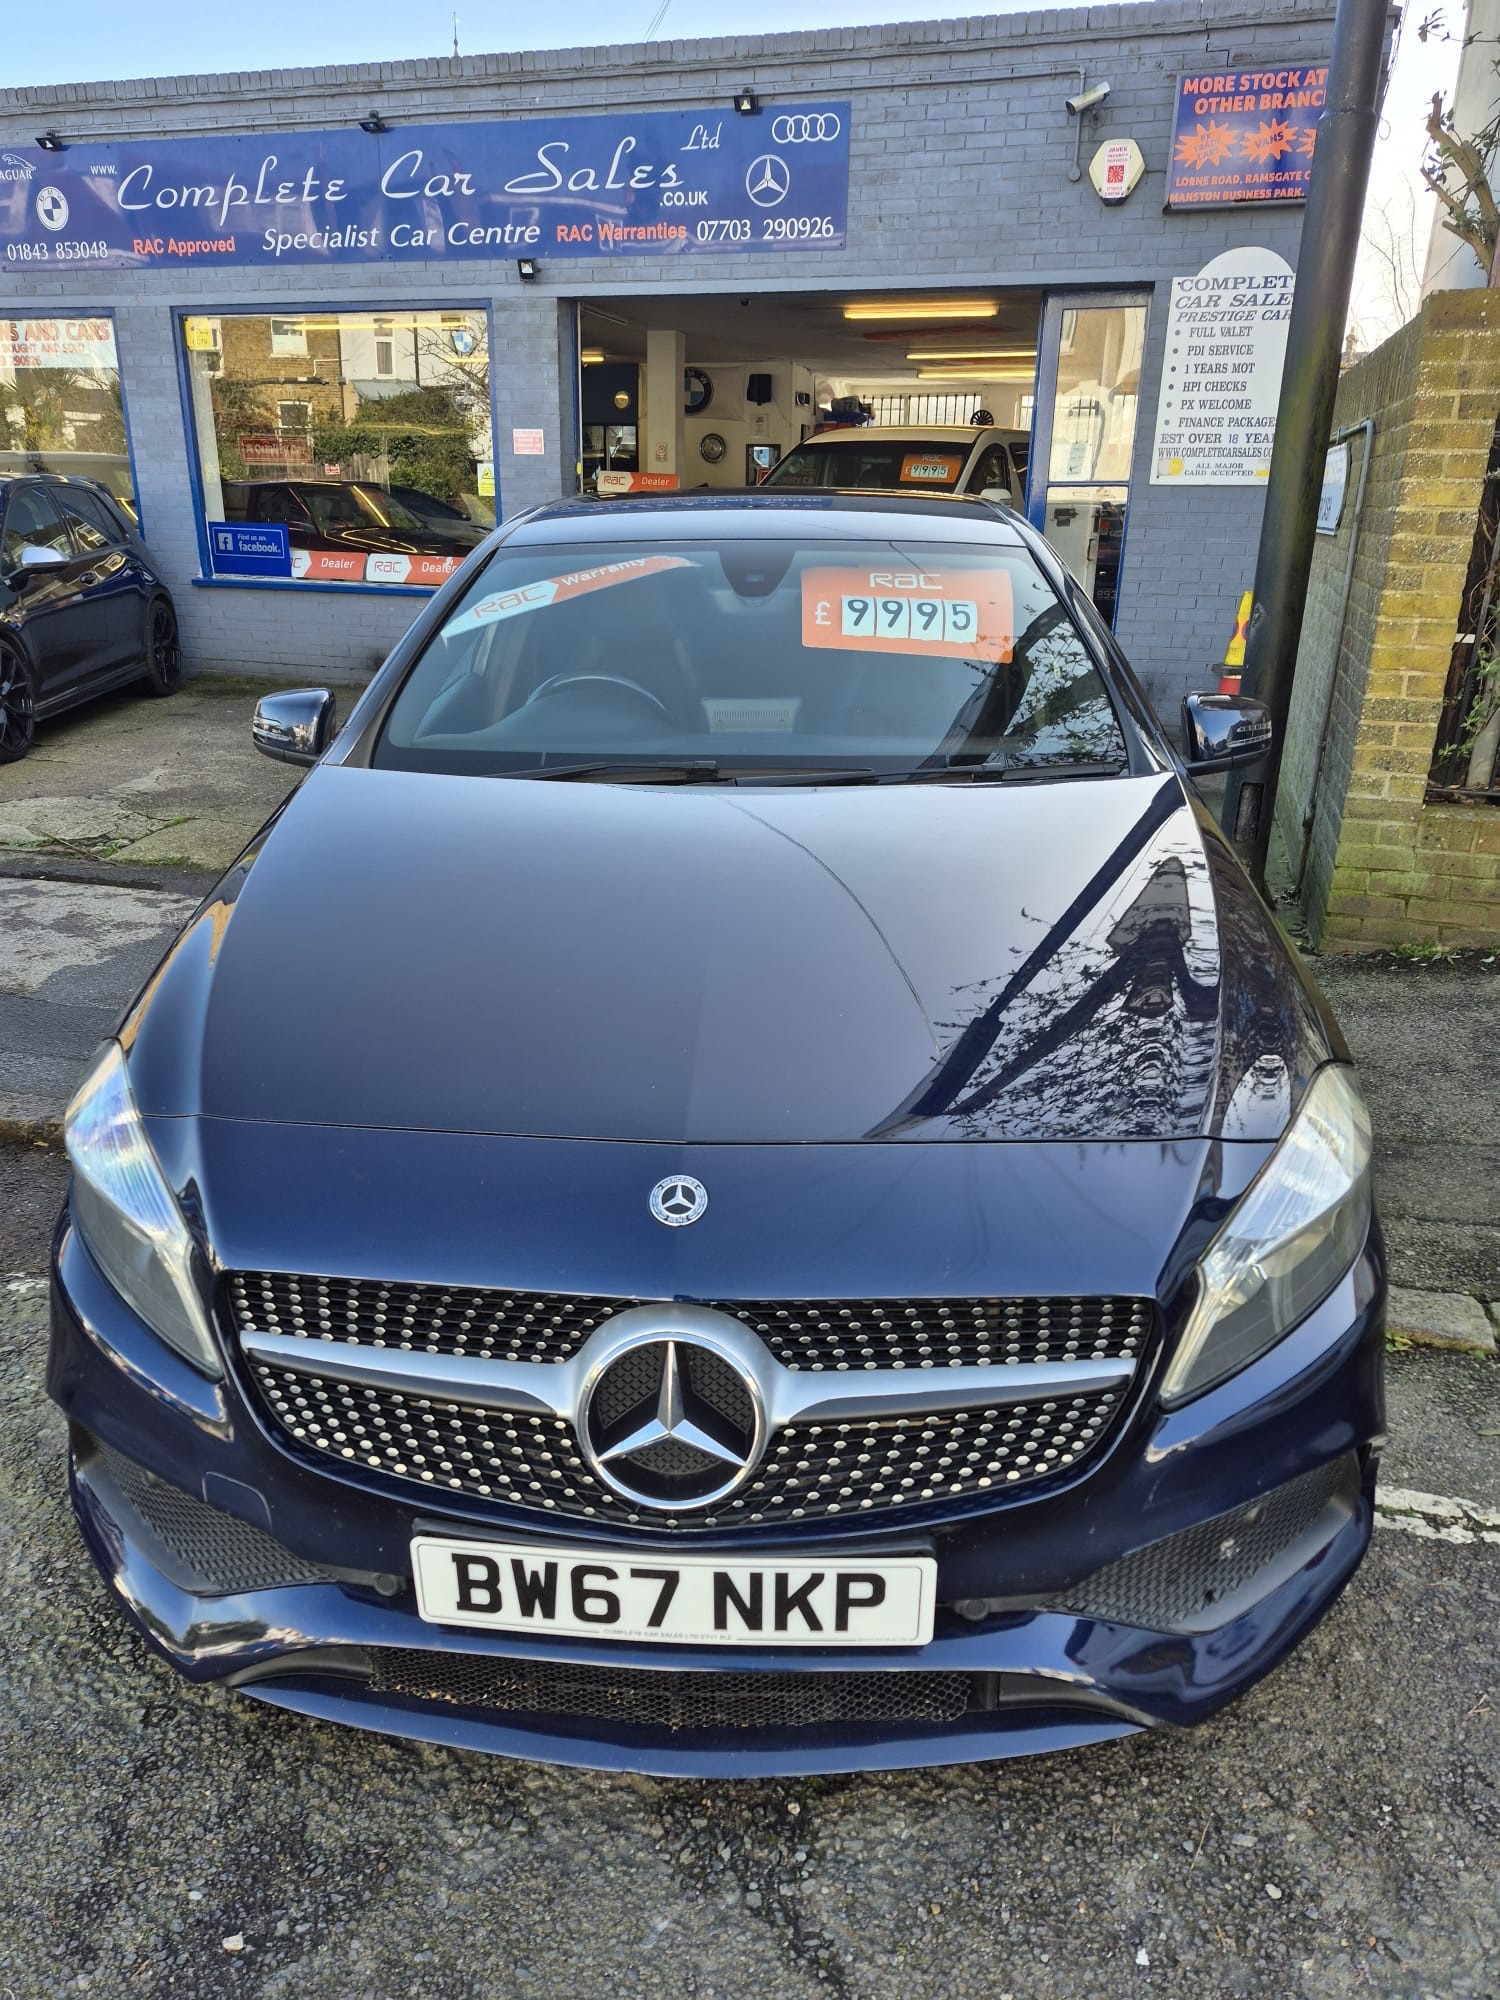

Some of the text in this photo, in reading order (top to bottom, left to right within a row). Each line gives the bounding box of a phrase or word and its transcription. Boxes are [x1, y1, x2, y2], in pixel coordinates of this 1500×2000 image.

[1183, 68, 1329, 95] MORE STOCK AT
[1194, 94, 1256, 115] OTHER
[1255, 130, 1284, 149] VANS
[117, 155, 348, 227] Complete
[381, 149, 476, 198] Car
[505, 136, 685, 193] Sales
[680, 121, 723, 151] Ltd
[1175, 175, 1209, 187] LORNE
[1245, 170, 1303, 184] RAMSGATE
[1170, 192, 1221, 203] MANSTON
[1222, 188, 1272, 200] BUSINESS
[7, 216, 834, 261] 01843 853048 RAC Approved Specialist Car Centre RAC Warranties 07703 290926
[1180, 275, 1296, 292] COMPLET
[1175, 294, 1222, 310] CAR
[1176, 309, 1258, 323] PRESTIGE
[24, 322, 60, 341] AND
[65, 321, 111, 341] CARS
[1189, 326, 1254, 338] FULL VALET
[1187, 344, 1255, 356] PDI SERVICE
[1184, 362, 1256, 375] 1 YEARS MOT
[1182, 380, 1248, 392] HPI CHECKS
[1180, 398, 1253, 410] PX WELCOME
[1178, 416, 1277, 428] FINANCE PACKAGE
[1160, 433, 1185, 444] EST
[1188, 433, 1223, 444] OVER
[1228, 433, 1239, 444] 18
[912, 464, 947, 475] 9995
[1195, 462, 1244, 470] ALL MAJOR
[1184, 469, 1254, 477] CARD ACCEPTED
[641, 476, 670, 486] Dealer
[237, 533, 250, 541] Find
[321, 557, 355, 569] Dealer
[421, 562, 456, 574] Dealer
[561, 556, 648, 587] Warranty
[815, 599, 971, 631] £ 9995
[451, 1552, 887, 1632] BW67 NKP
